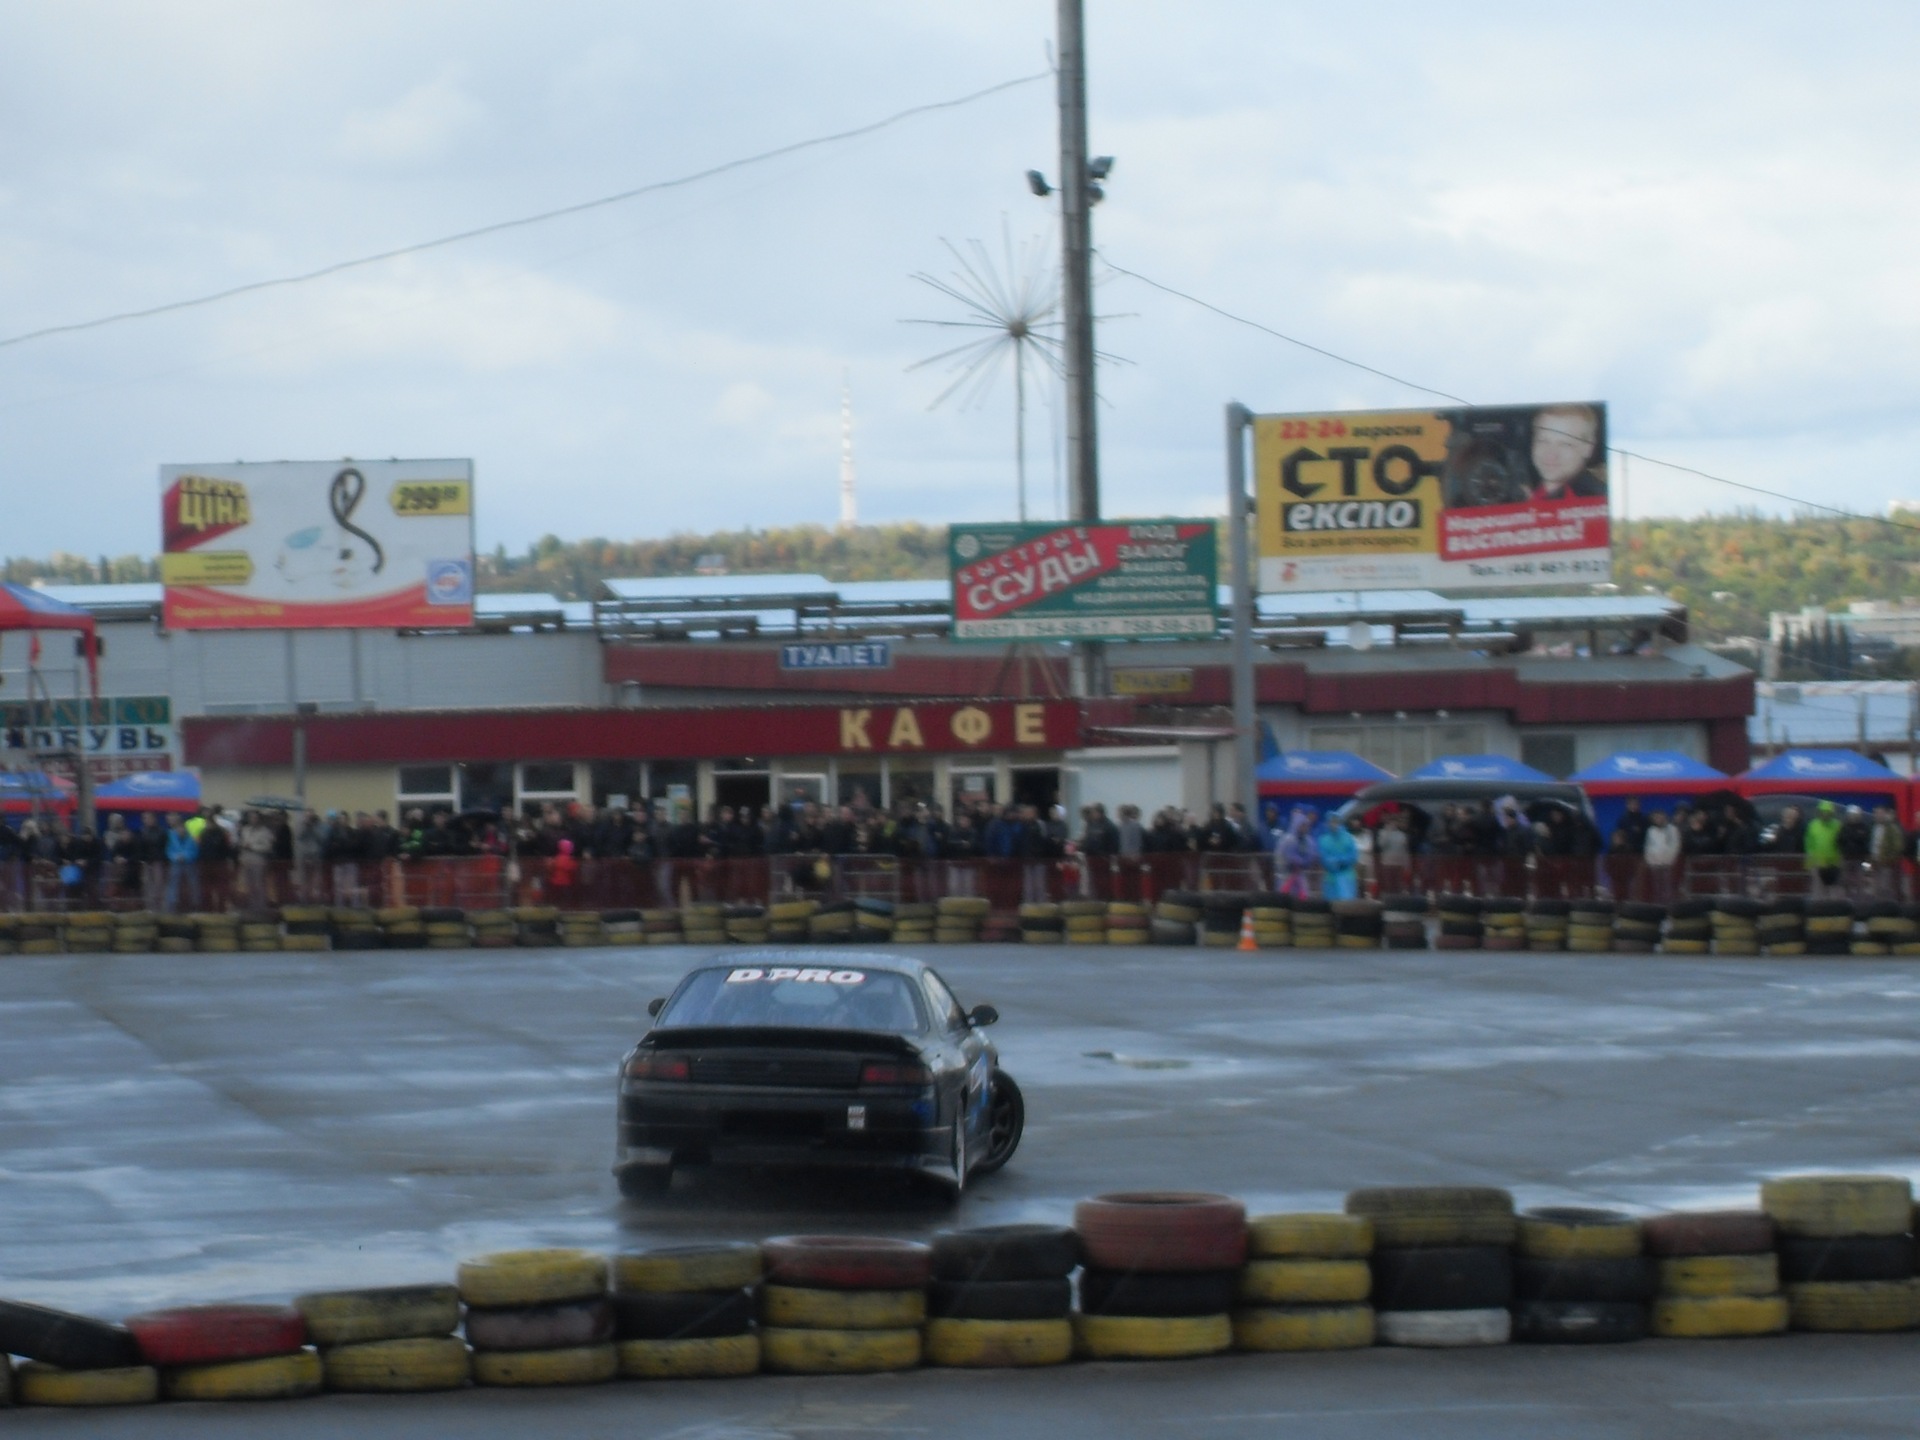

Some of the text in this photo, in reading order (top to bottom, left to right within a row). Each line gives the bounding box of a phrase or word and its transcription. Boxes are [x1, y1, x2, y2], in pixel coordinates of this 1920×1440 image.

[1280, 443, 1424, 499] СТО
[1287, 500, 1416, 532] експо
[957, 526, 1090, 586] БЫСТРЫЕ
[966, 542, 1100, 612] ССУДЫ
[784, 644, 886, 667] ТУАЛЕТ
[839, 703, 1047, 749] КАФЕ
